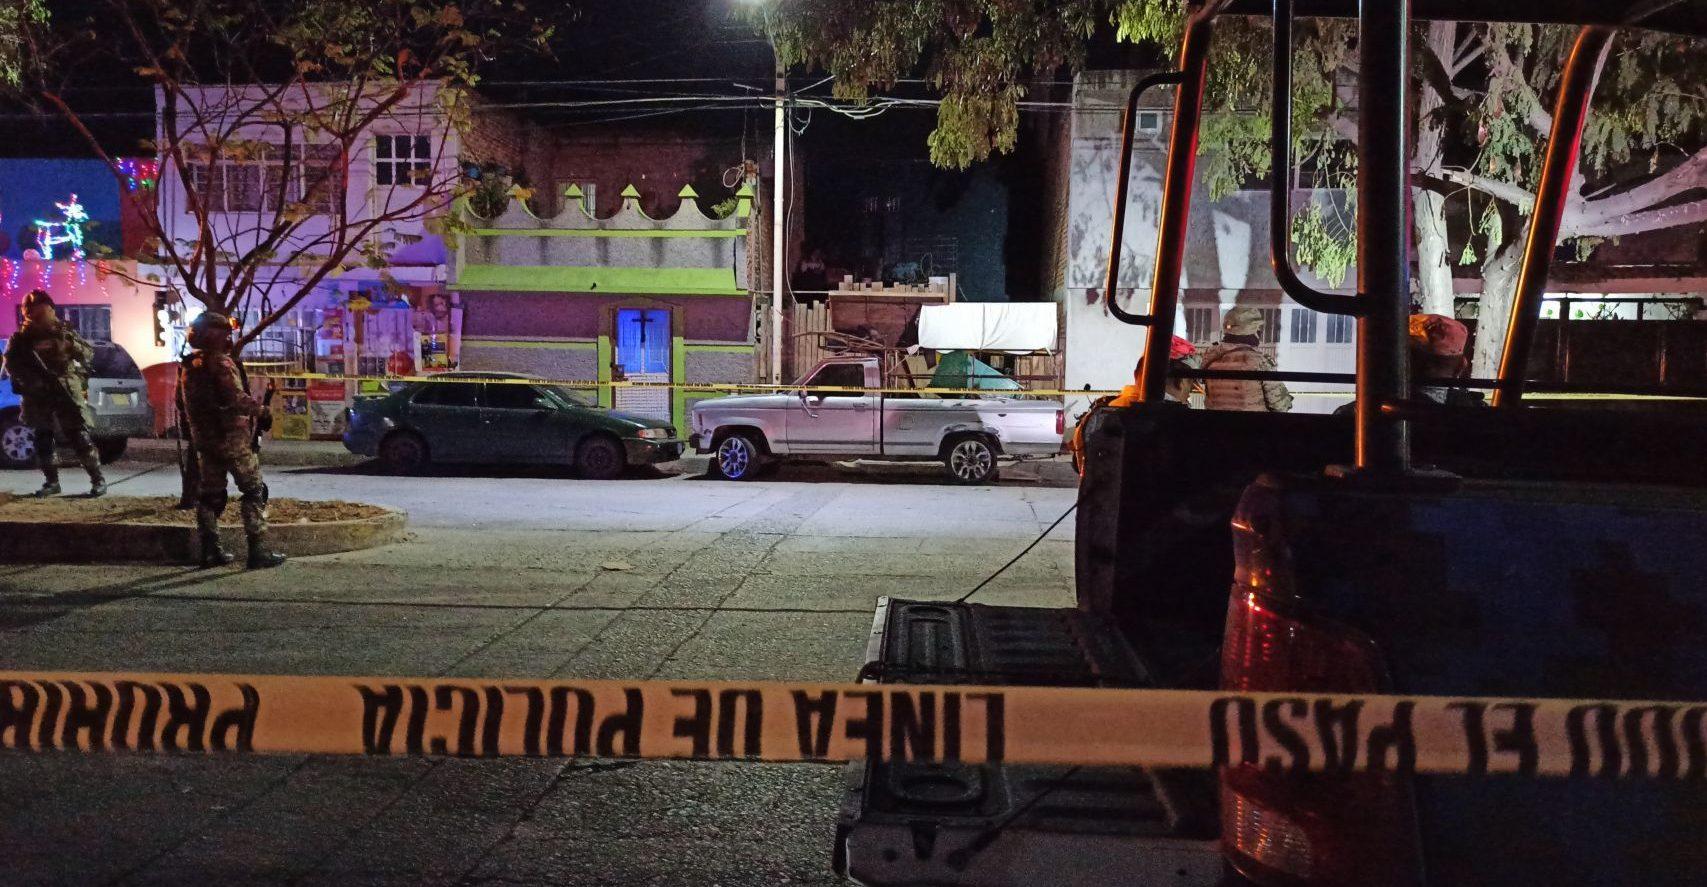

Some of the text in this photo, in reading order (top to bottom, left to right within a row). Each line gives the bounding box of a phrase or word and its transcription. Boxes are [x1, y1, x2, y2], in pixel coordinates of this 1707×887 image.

[352, 685, 644, 757] POLICIA
[671, 687, 763, 759] DE
[790, 689, 1005, 763] LINEA
[1210, 697, 1416, 771] PASO
[1446, 702, 1539, 774] EL
